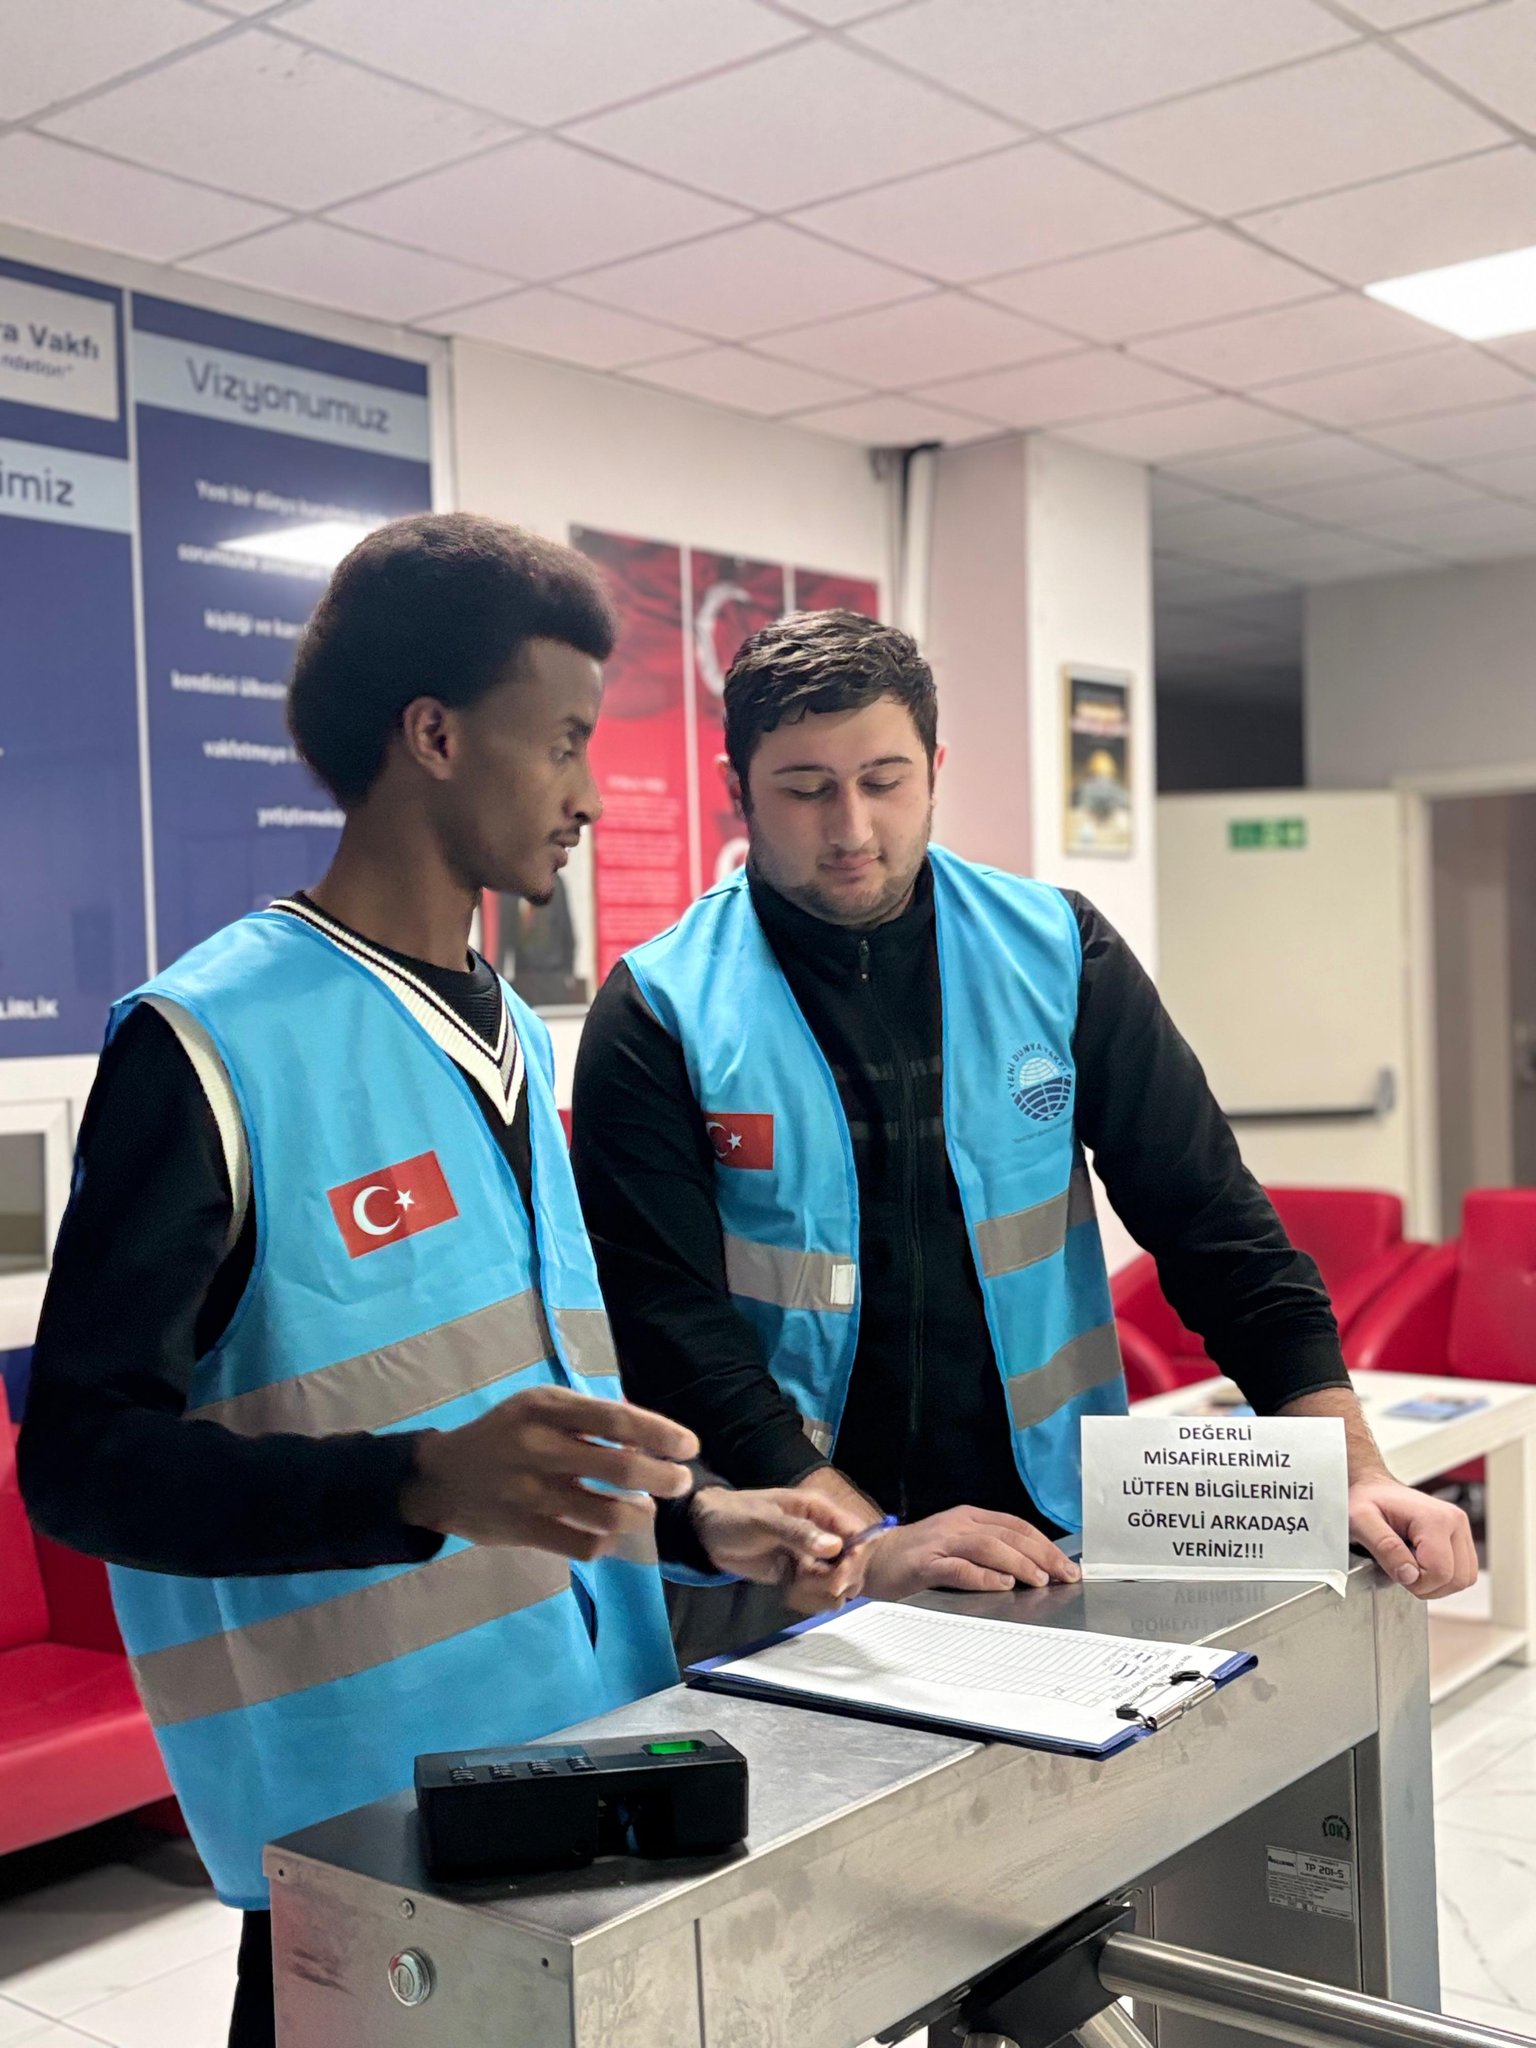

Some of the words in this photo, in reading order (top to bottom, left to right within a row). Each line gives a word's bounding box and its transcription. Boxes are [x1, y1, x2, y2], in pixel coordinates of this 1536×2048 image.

[186, 356, 391, 435] Vizyonumuz
[1179, 1424, 1251, 1441] DEĞERLİ
[1143, 1448, 1291, 1468] MİSAFİRLERİMİZ
[1122, 1477, 1189, 1497] LÜTFEN
[1195, 1479, 1314, 1500] BİLGİLERİNİZİ
[1128, 1509, 1206, 1529] GÖREVLİ
[1210, 1516, 1309, 1535] ARKADAŞA
[1172, 1539, 1264, 1559] VERİNİZ!!!
[1305, 1862, 1316, 1873] TP
